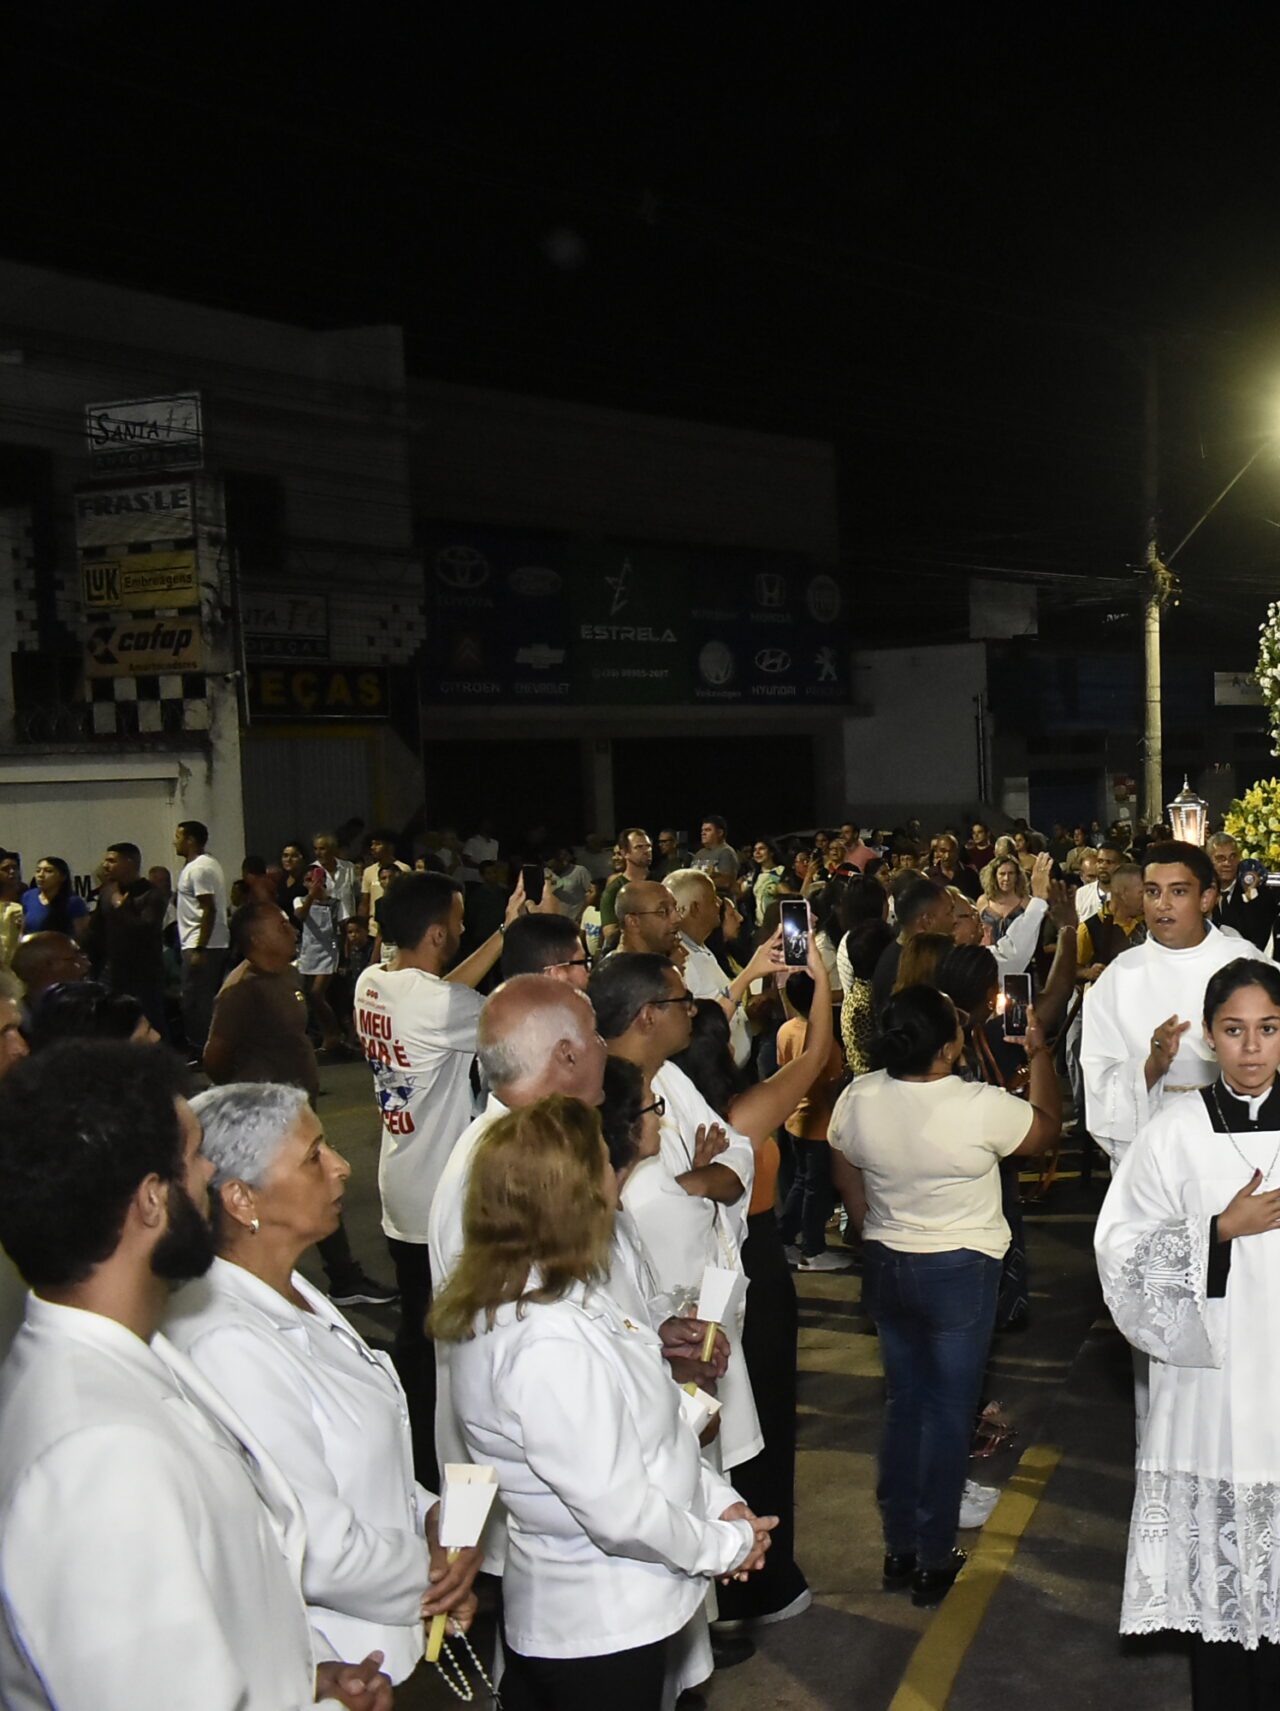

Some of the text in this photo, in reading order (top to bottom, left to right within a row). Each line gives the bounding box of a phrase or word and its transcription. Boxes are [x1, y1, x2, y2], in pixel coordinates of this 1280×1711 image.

[95, 413, 159, 445] SANTA
[118, 622, 192, 657] cofap
[580, 624, 678, 643] ESTRELA
[250, 670, 383, 713] EÇAS
[752, 685, 796, 696] HYUNDAI
[359, 1008, 392, 1041] MEU
[393, 1039, 411, 1067] É
